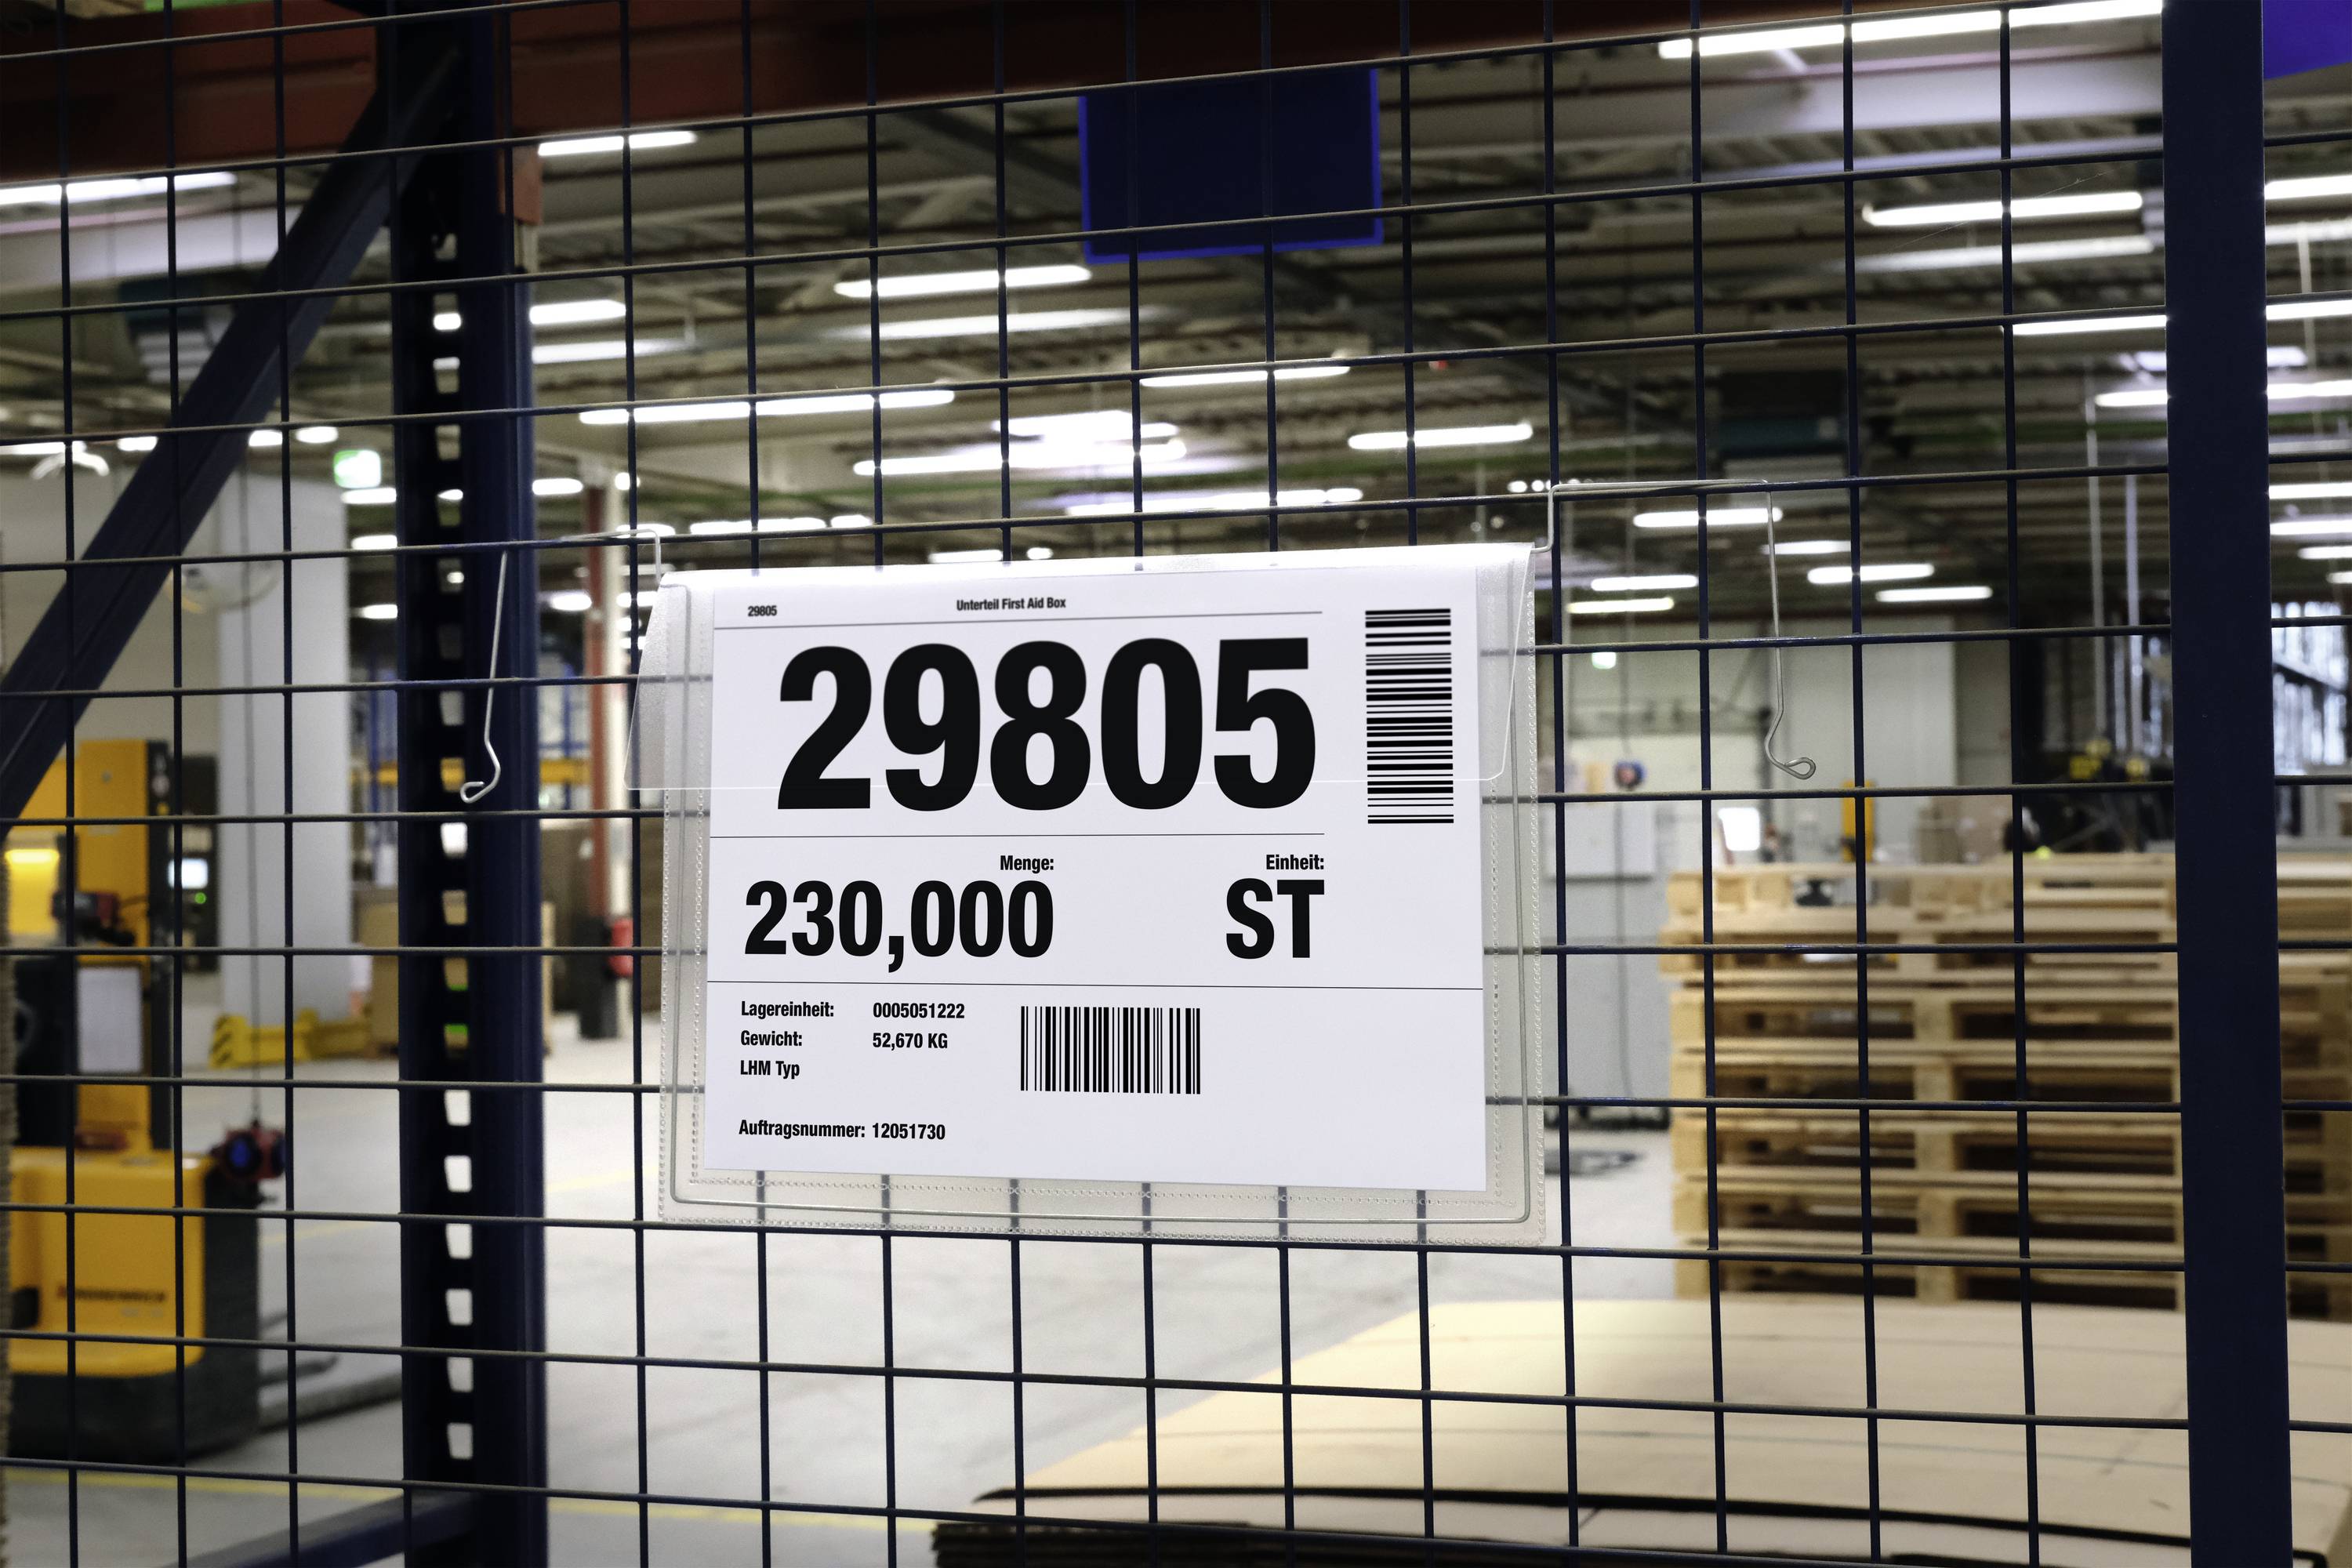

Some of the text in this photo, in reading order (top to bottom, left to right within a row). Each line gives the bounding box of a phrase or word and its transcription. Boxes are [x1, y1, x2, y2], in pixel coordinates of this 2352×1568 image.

[747, 605, 777, 617] 29805
[956, 597, 1066, 611] Unterteil First Aid Box
[777, 637, 1316, 812] 29805
[1000, 854, 1054, 874] Menge:
[1266, 854, 1324, 870] Einheit:
[744, 880, 1054, 973] 230,000
[1225, 877, 1325, 960] ST
[741, 1000, 965, 1020] Lagereinheit: 0005051222
[740, 1029, 948, 1051] Gewicht: 52,670 KG
[740, 1059, 800, 1080] LHM Typ
[739, 1119, 946, 1140] Auftragsnummer: 12051730
